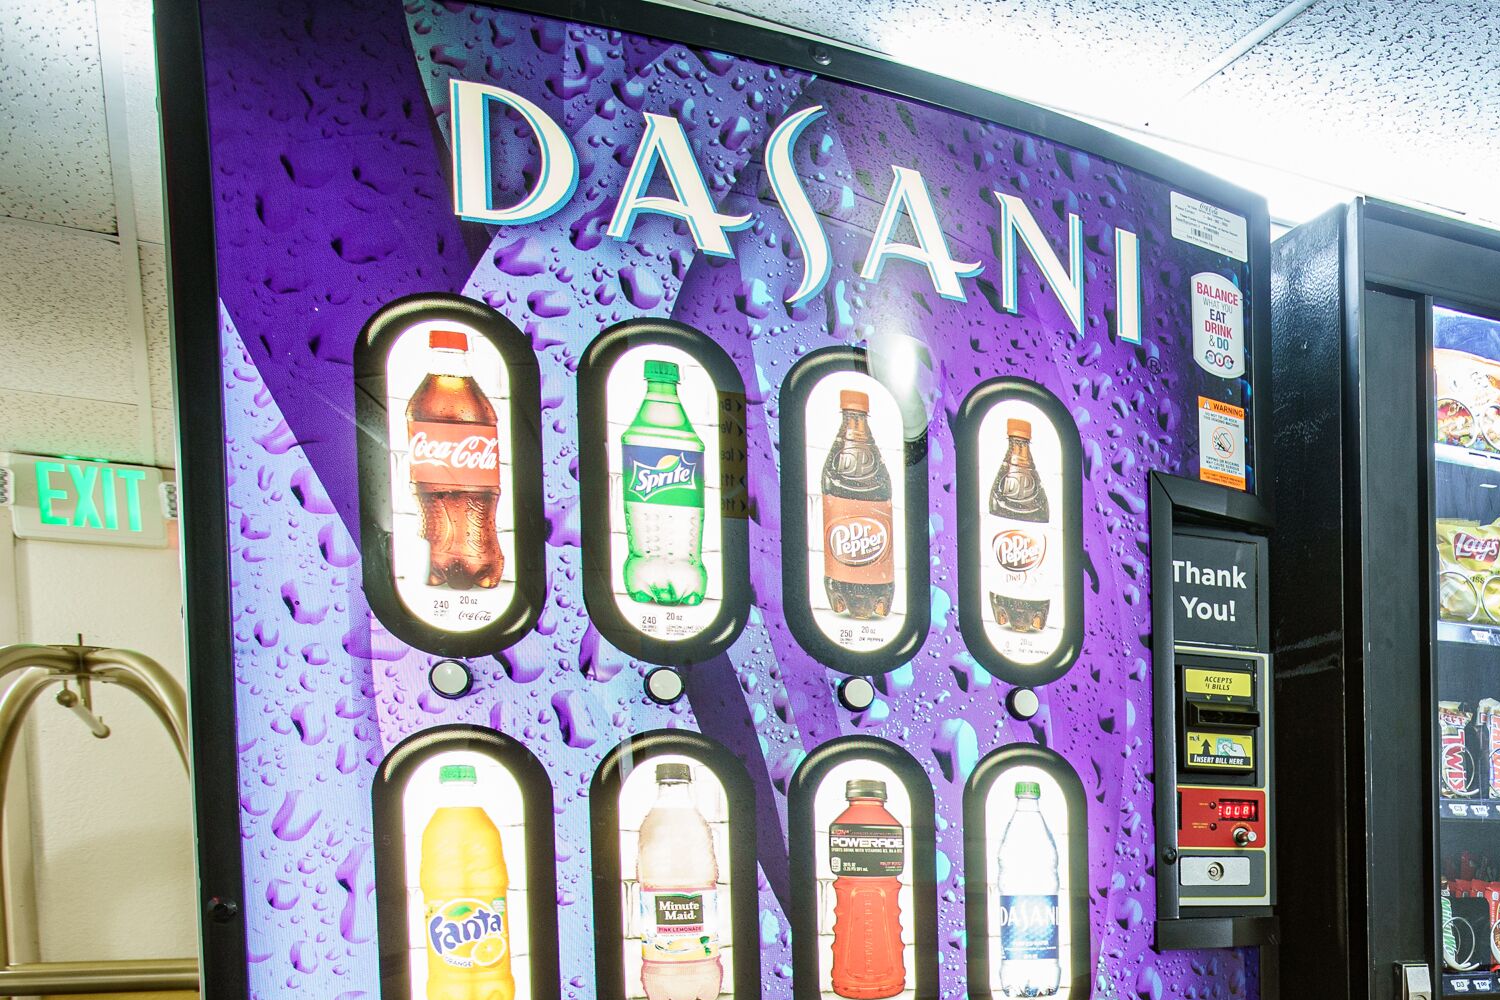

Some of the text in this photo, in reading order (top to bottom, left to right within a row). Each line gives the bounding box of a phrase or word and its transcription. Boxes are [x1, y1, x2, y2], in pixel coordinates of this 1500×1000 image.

[448, 77, 1142, 345] DASANI
[1196, 281, 1239, 307] BALANCE
[1202, 297, 1233, 314] WHAT YOU
[1209, 308, 1227, 324] EAT
[1204, 320, 1233, 340] DRINK
[1208, 334, 1230, 351] & DO
[1213, 402, 1243, 418] WARNING
[408, 430, 499, 470] Coca-Cola
[634, 462, 691, 494] Sprite
[35, 461, 146, 532] EXIT
[849, 522, 872, 541] Dr
[834, 524, 884, 558] Pepper
[1015, 535, 1031, 550] Dr
[1172, 560, 1247, 589] Thank
[434, 595, 478, 610] 240 20 oz
[1180, 596, 1236, 622] You!
[642, 616, 657, 625] 240
[666, 612, 676, 620] 20
[840, 629, 853, 638] 250
[861, 626, 870, 634] 20
[1204, 676, 1233, 684] ACCEPTS
[1194, 754, 1214, 764] INSERT
[1215, 756, 1227, 764] BILL
[830, 837, 904, 848] POWERADE
[658, 901, 700, 911] Minute
[664, 910, 696, 920] Maid
[1000, 904, 1059, 930] DASANI
[429, 908, 502, 954] Fanta
[444, 956, 472, 968] ORANGE
